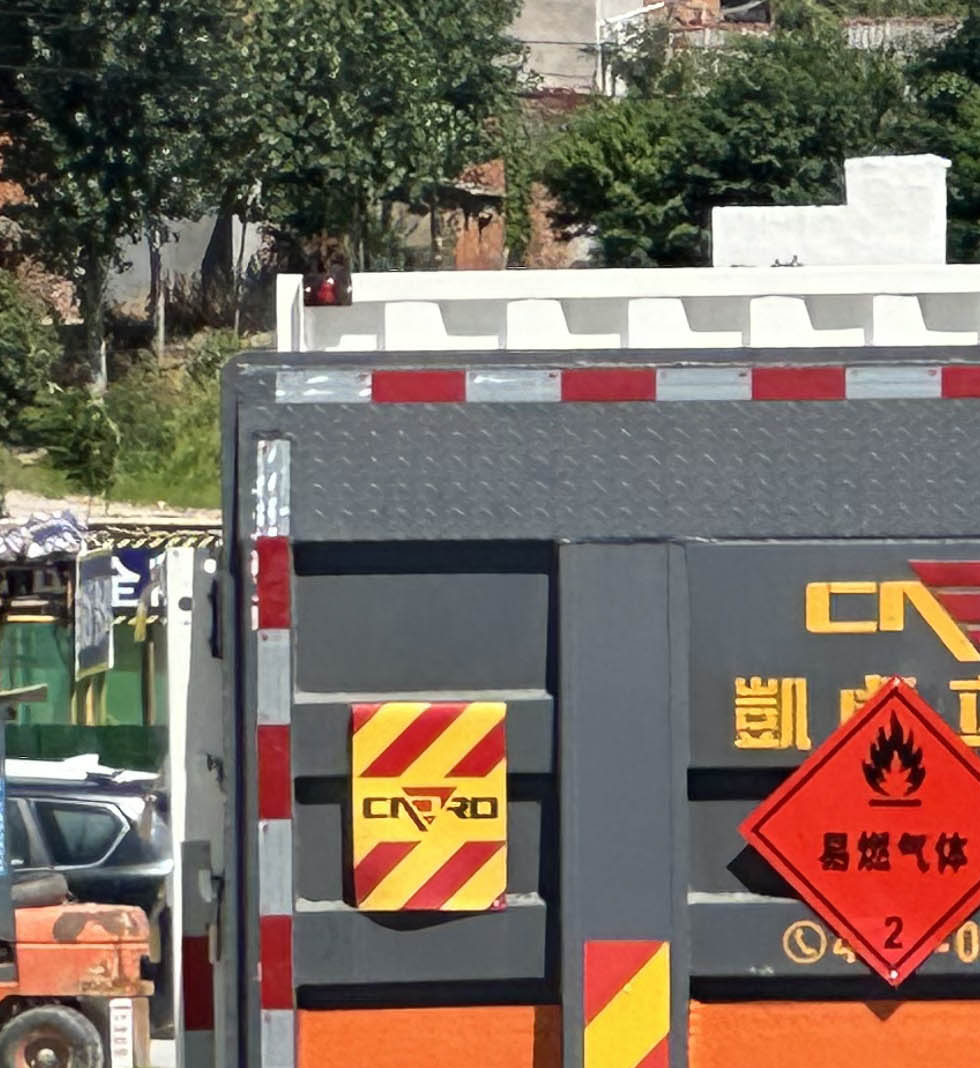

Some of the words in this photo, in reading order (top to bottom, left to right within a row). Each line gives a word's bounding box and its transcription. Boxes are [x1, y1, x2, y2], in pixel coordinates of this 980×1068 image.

[818, 831, 969, 875] 易燃气体
[884, 915, 904, 949] 2
